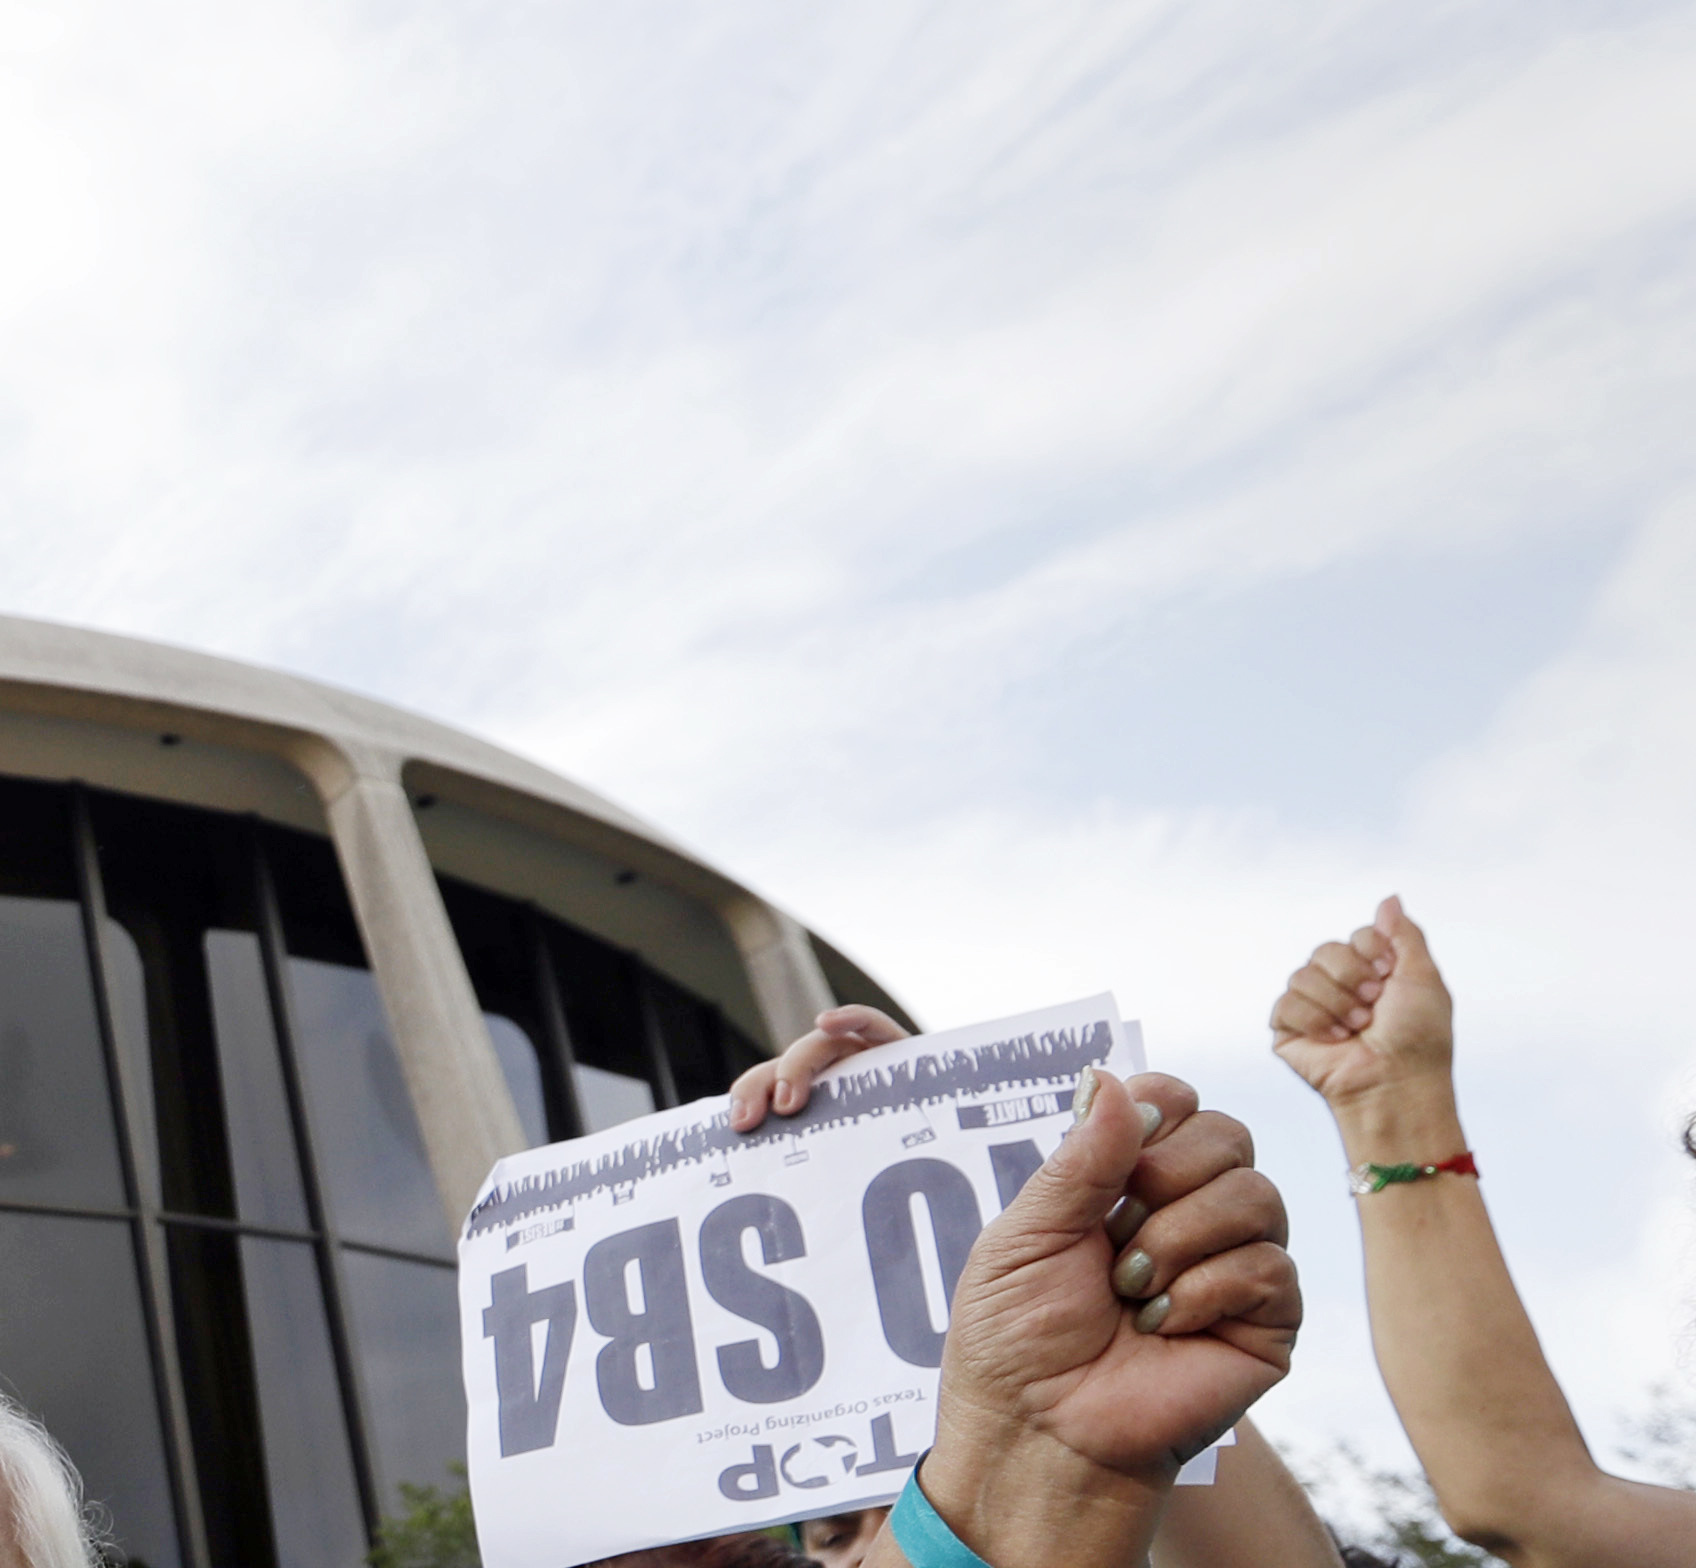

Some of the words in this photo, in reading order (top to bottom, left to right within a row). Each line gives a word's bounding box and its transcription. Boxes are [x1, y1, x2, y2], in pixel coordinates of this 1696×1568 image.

[482, 1193, 825, 1458] SB4
[872, 1387, 928, 1408] Texas
[764, 1400, 869, 1432] Organizing
[696, 1421, 760, 1445] Project
[718, 1411, 919, 1502] TOP
